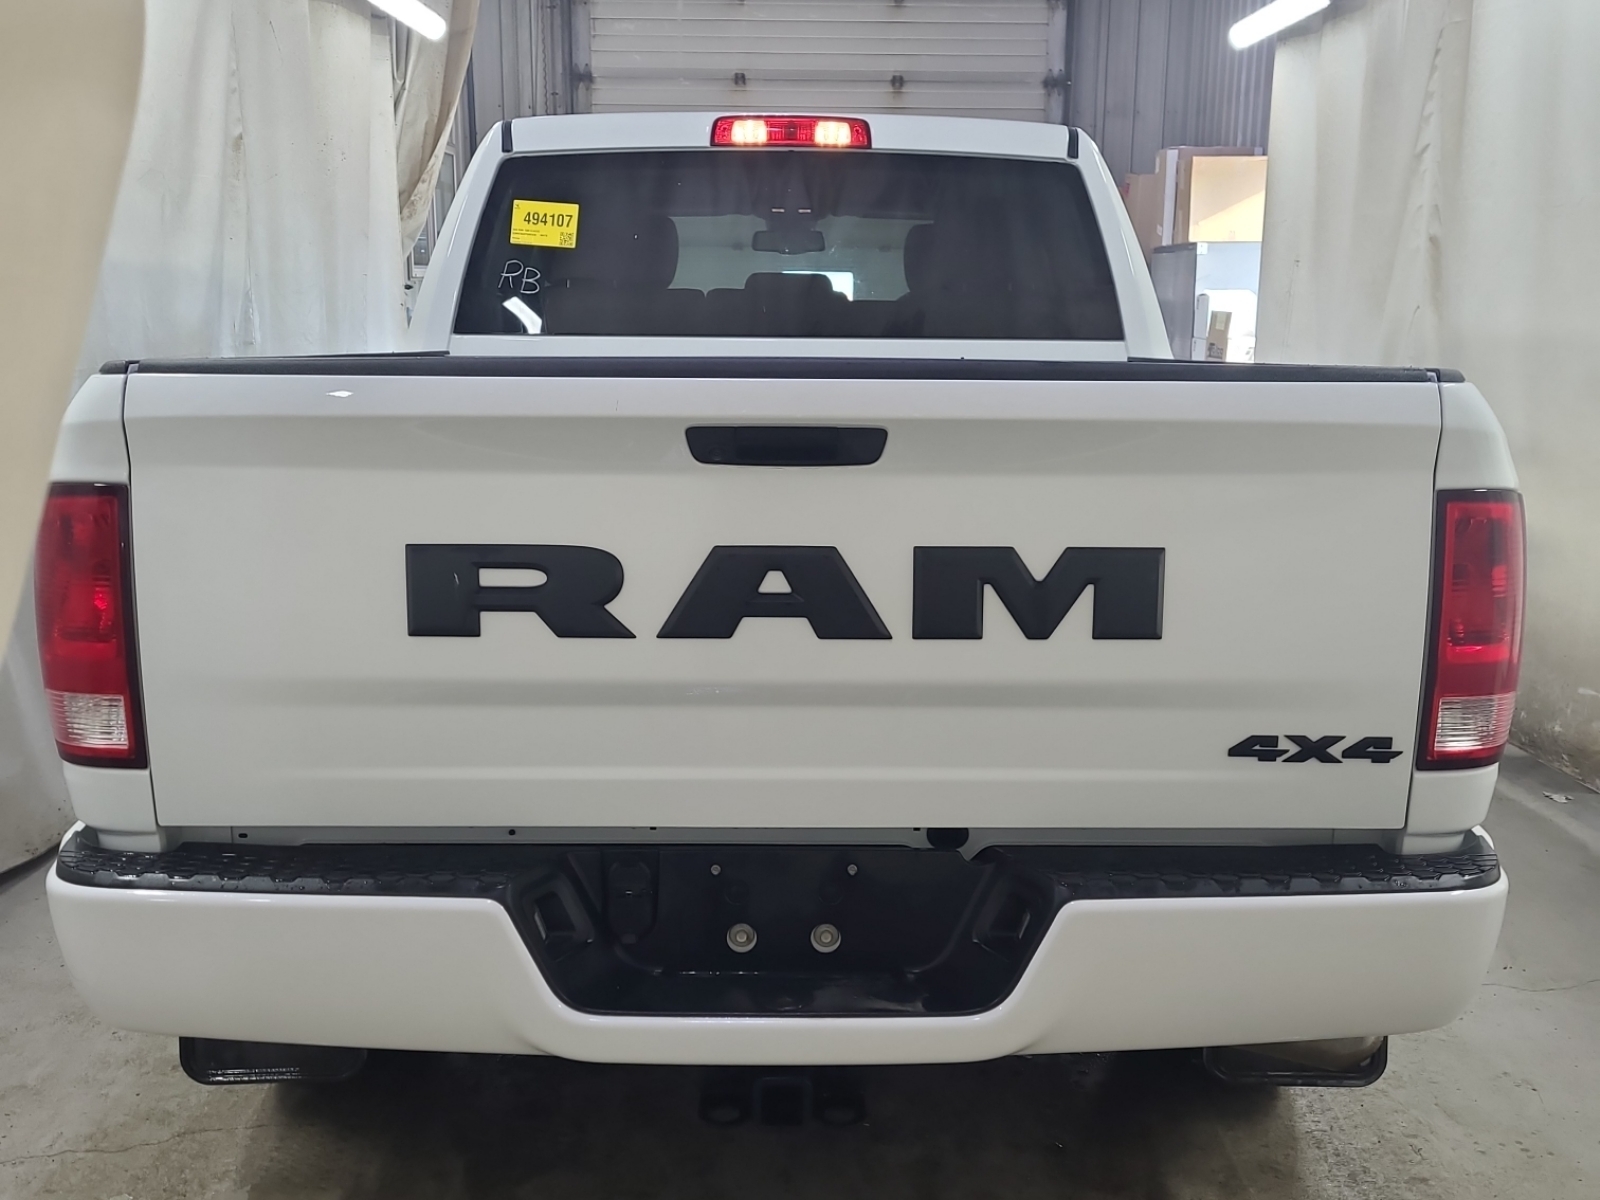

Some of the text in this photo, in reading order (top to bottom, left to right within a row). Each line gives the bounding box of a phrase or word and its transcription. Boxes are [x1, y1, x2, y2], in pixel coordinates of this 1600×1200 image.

[523, 211, 574, 228] 494107
[497, 259, 542, 295] RB
[405, 543, 1166, 641] RAM
